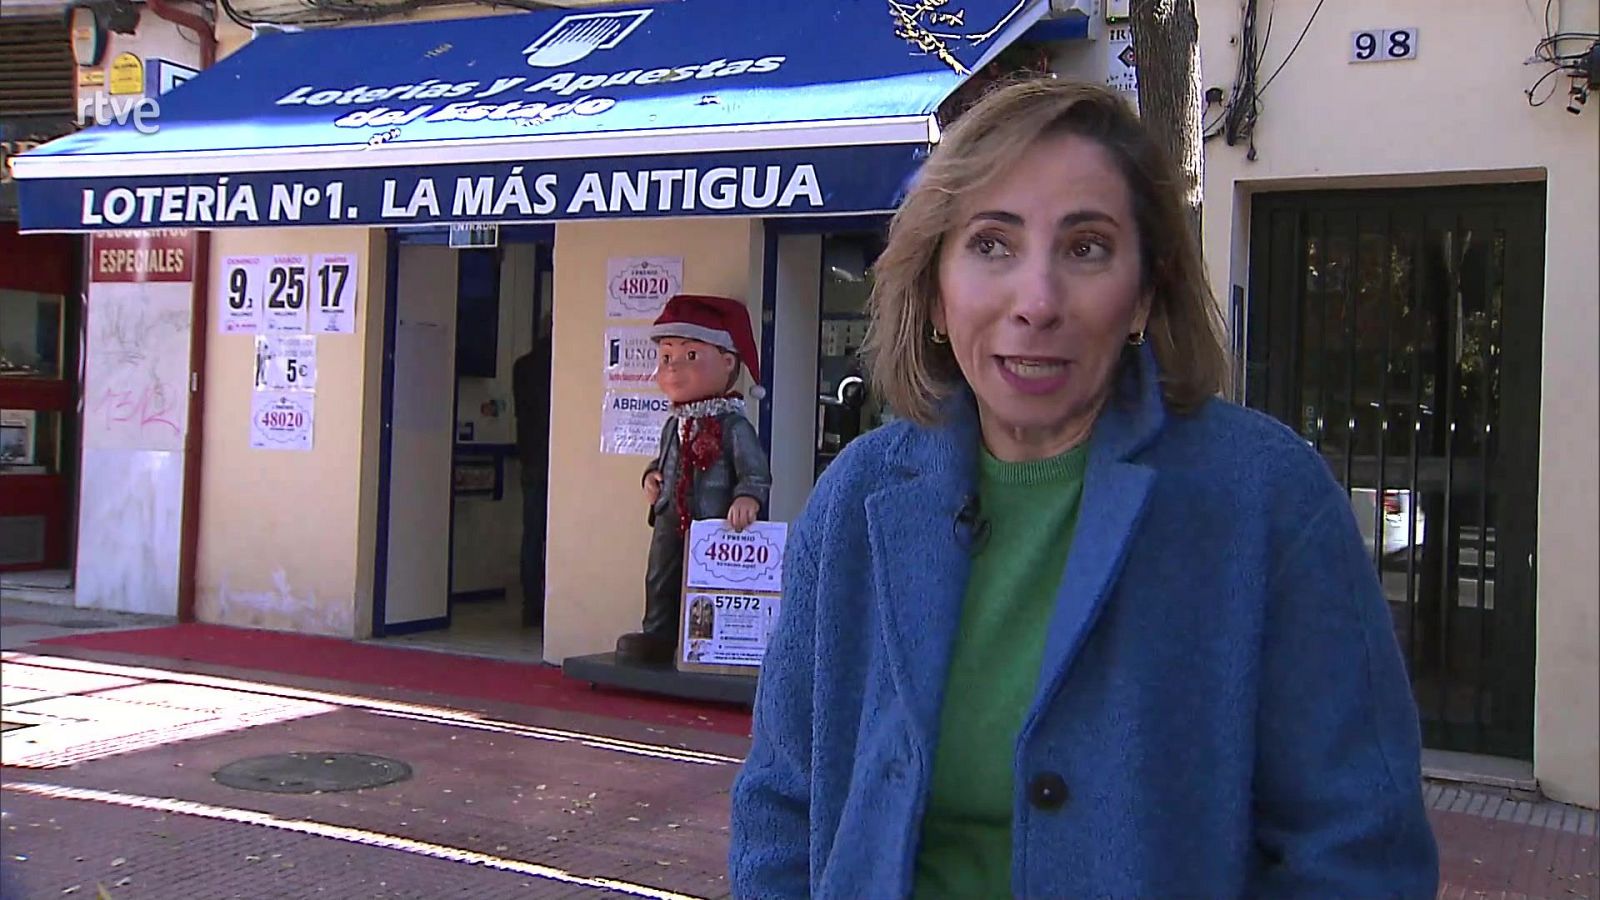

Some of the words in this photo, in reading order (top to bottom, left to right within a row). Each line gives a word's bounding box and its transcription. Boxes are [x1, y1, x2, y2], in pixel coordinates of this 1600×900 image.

[1354, 29, 1412, 60] 98
[276, 80, 480, 105] Loterías
[476, 76, 526, 98] y
[524, 56, 787, 96] Apuestas
[334, 104, 431, 128] del
[427, 95, 617, 122] Estado
[81, 176, 259, 226] LOTERÍA
[381, 178, 443, 219] LA
[451, 166, 559, 216] MÁS
[566, 163, 824, 213] ANTIGUA
[99, 248, 185, 274] ESPECIALES
[268, 266, 306, 309] 25
[317, 264, 350, 308] 17
[619, 277, 669, 296] 48020
[624, 347, 657, 361] UNO
[612, 398, 669, 411] ABRIMOS
[261, 411, 304, 428] 48020
[704, 541, 769, 564] 48020
[715, 595, 760, 610] 57572
